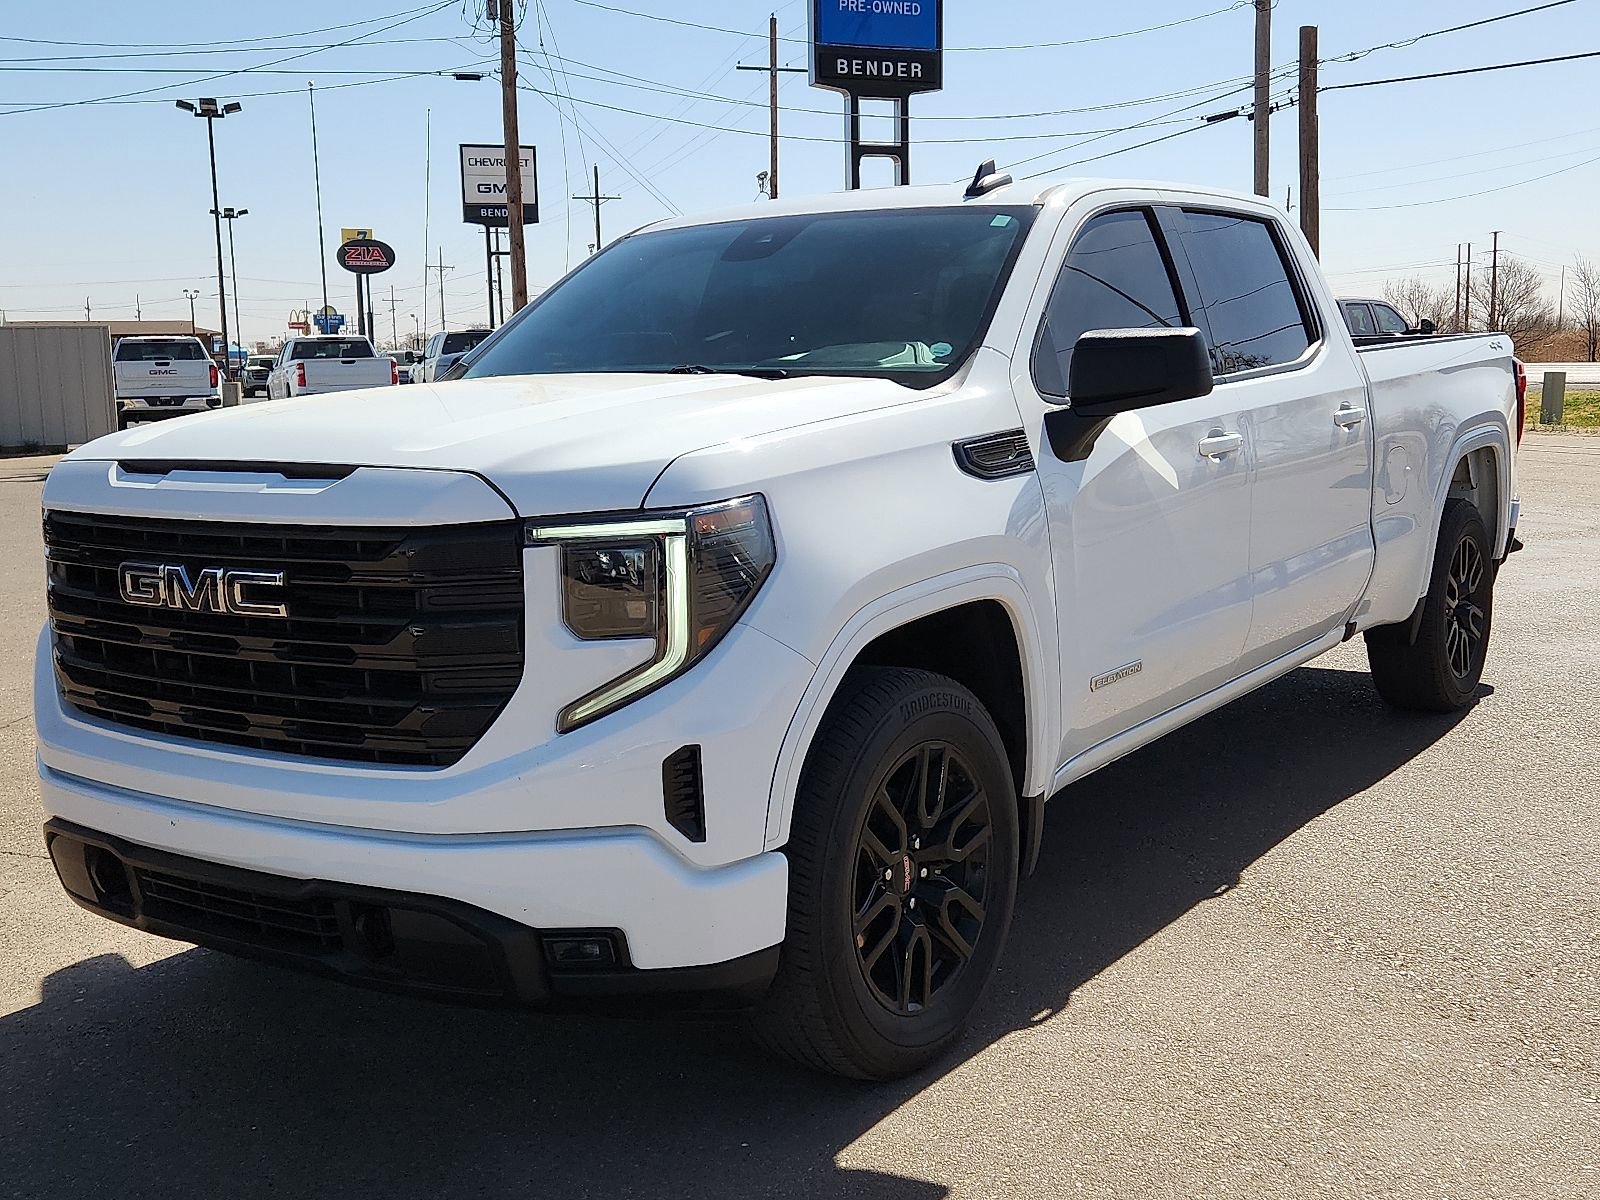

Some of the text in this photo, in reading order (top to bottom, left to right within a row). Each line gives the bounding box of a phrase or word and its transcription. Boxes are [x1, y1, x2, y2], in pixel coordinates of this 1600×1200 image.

[838, 0, 921, 16] PRE-OWNED
[836, 58, 922, 78] BENDER
[468, 157, 530, 168] CHEVRET
[477, 183, 523, 194] GM
[480, 208, 509, 217] BEND
[344, 246, 387, 262] ZIA
[118, 561, 288, 618] GMC
[900, 692, 973, 721] BRIDGESTONE
